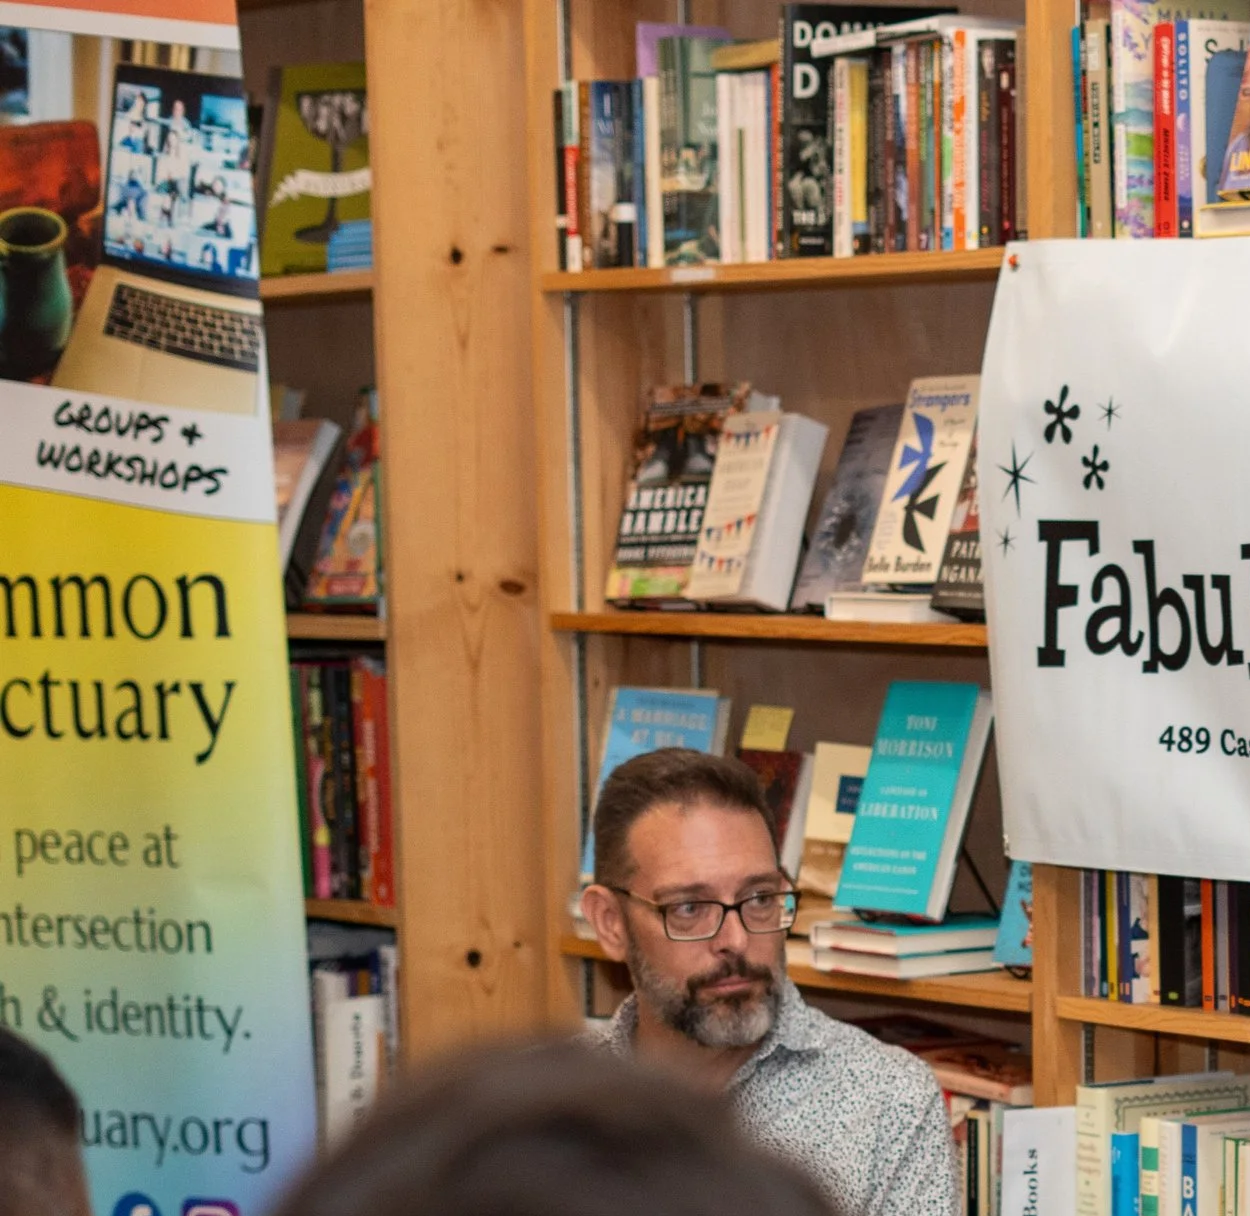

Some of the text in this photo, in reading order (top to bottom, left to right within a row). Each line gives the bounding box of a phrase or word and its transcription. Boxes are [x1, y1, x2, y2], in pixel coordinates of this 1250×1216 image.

[53, 400, 169, 445] GROUPS
[36, 441, 229, 495] WORKSHOPS
[894, 556, 932, 574] Burden
[0, 572, 233, 640] mmon
[0, 670, 237, 766] ctuary
[906, 715, 938, 731] TONI
[1159, 725, 1211, 755] 489
[877, 739, 954, 758] MORRISON
[860, 803, 939, 821] LIBERATION
[14, 824, 181, 878] peace at
[83, 985, 253, 1056] identity.
